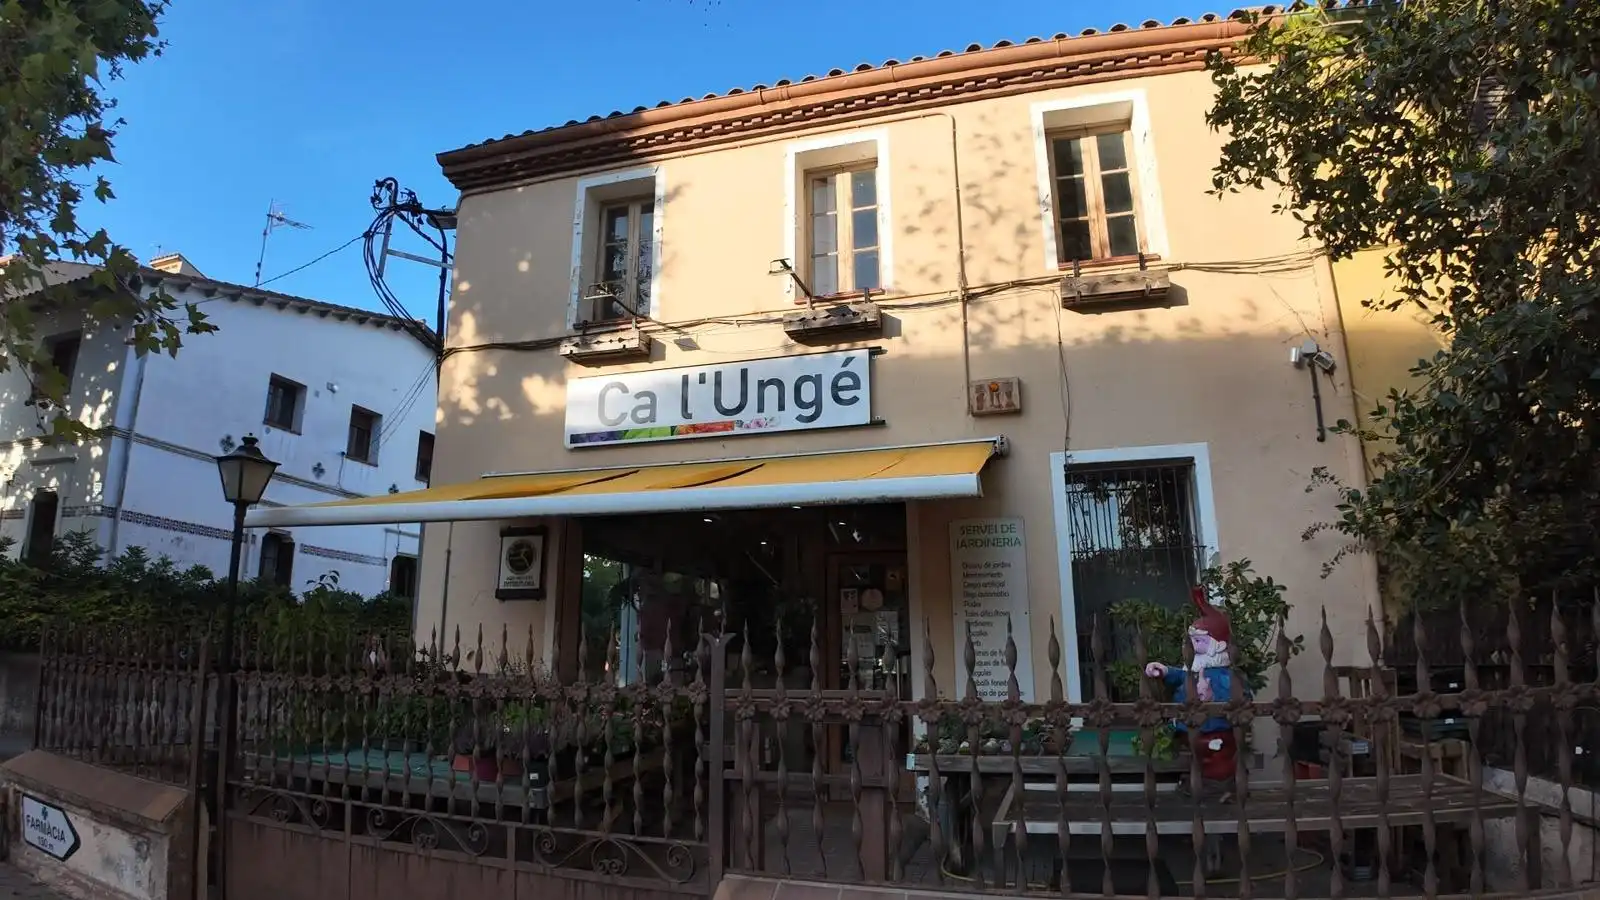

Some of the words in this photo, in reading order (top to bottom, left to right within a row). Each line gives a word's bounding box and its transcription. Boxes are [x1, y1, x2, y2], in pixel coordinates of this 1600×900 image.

[597, 381, 657, 427] Ca
[680, 356, 862, 424] l'Ungé
[960, 524, 998, 536] SERVEI
[999, 523, 1017, 534] DE
[956, 536, 1022, 550] JARDINERIA
